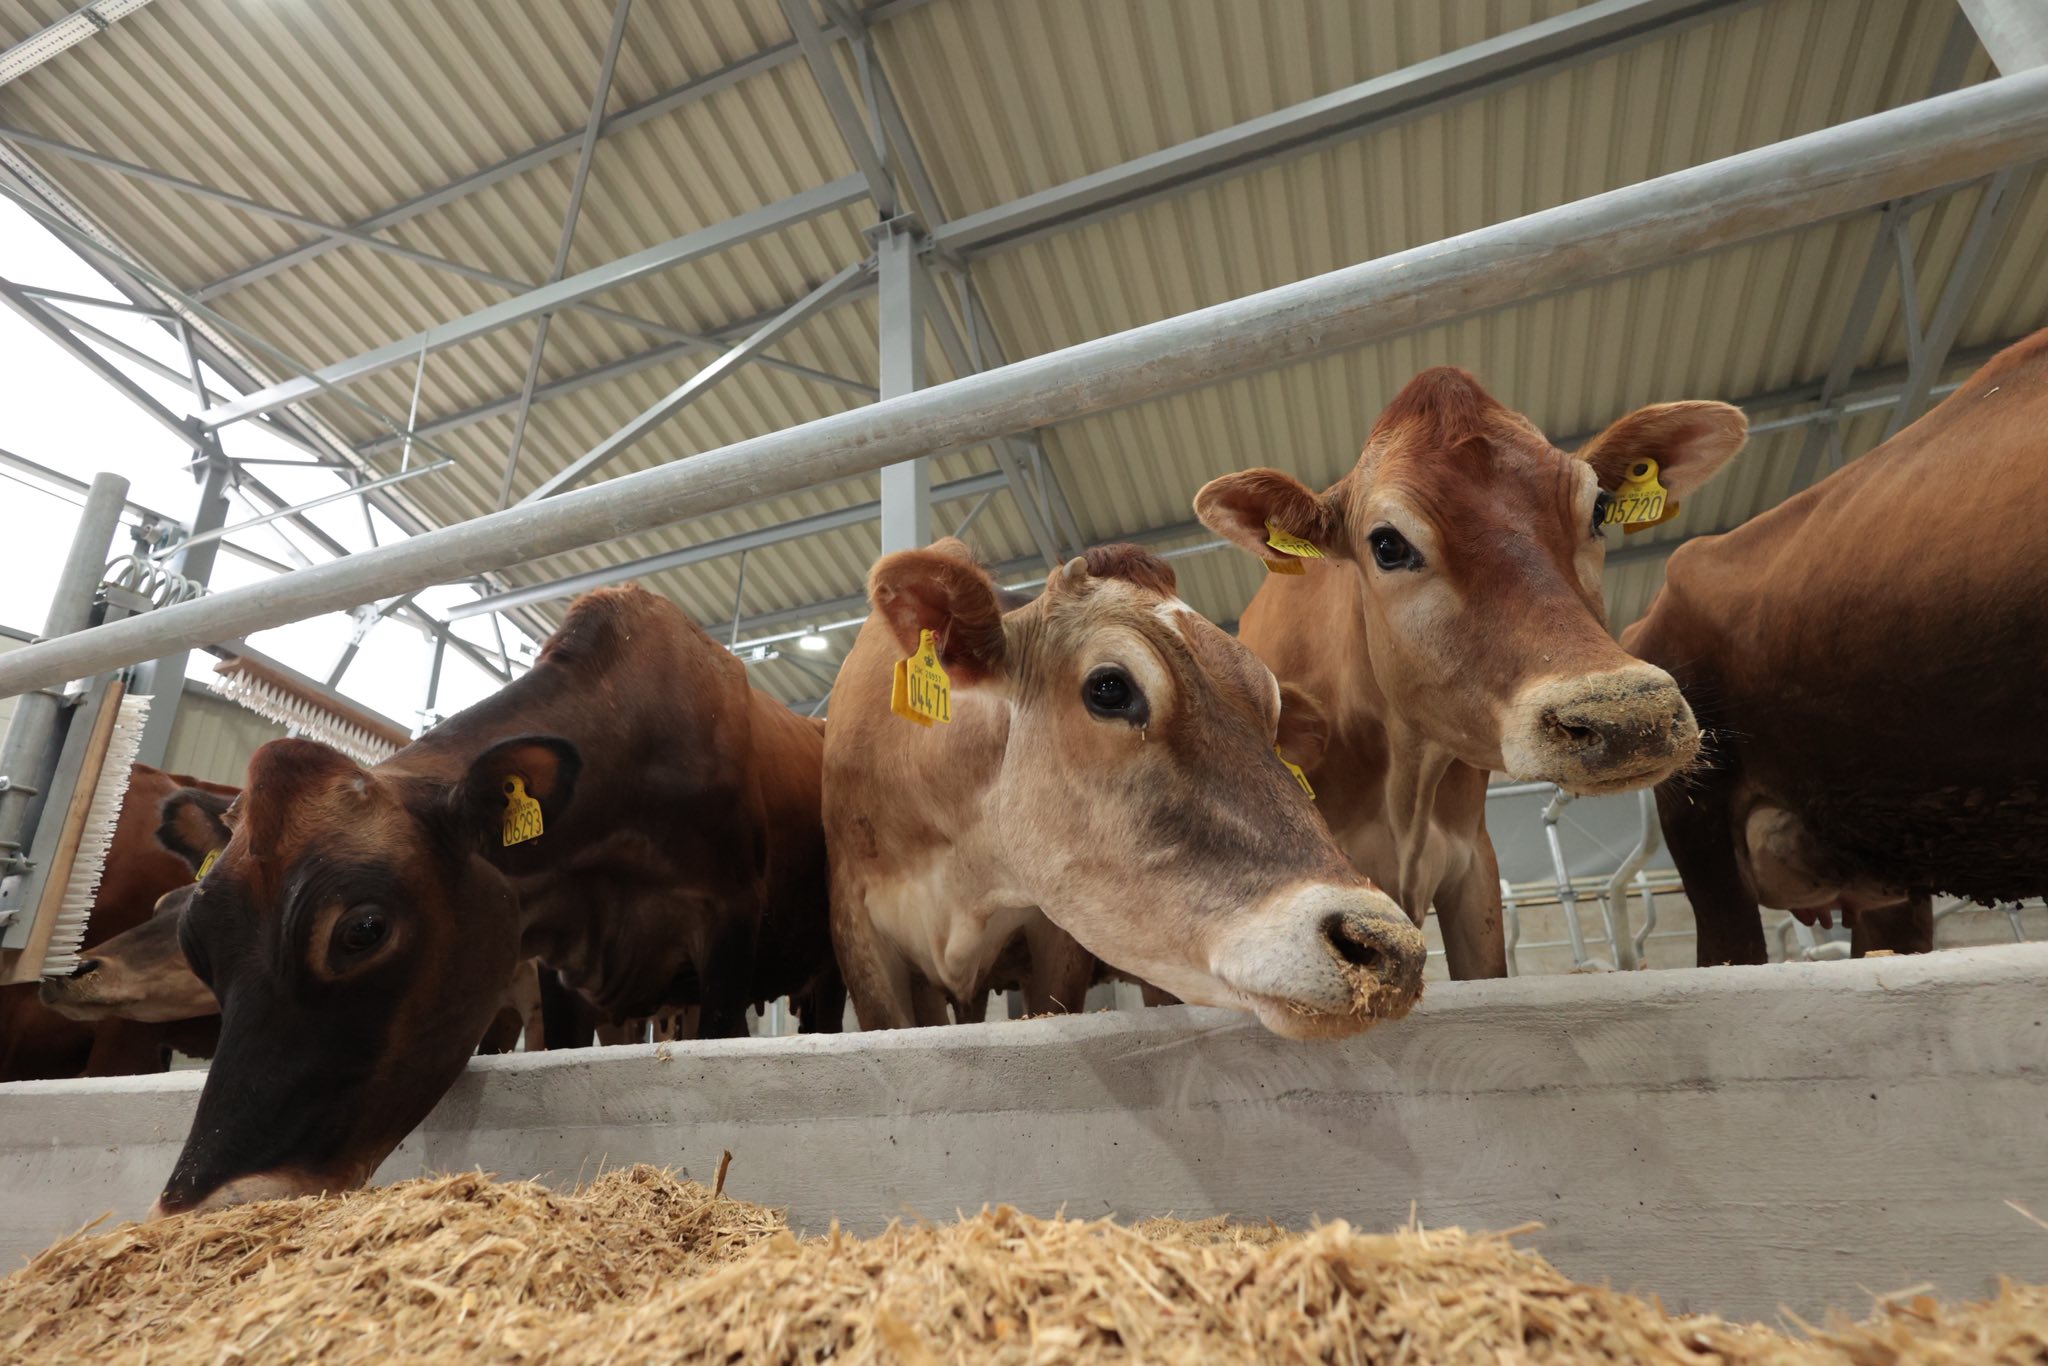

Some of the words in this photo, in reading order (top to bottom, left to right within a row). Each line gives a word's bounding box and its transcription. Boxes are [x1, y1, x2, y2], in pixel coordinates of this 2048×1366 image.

[1604, 495, 1662, 523] 05720
[910, 672, 950, 721] 04471
[505, 808, 542, 844] 06293
